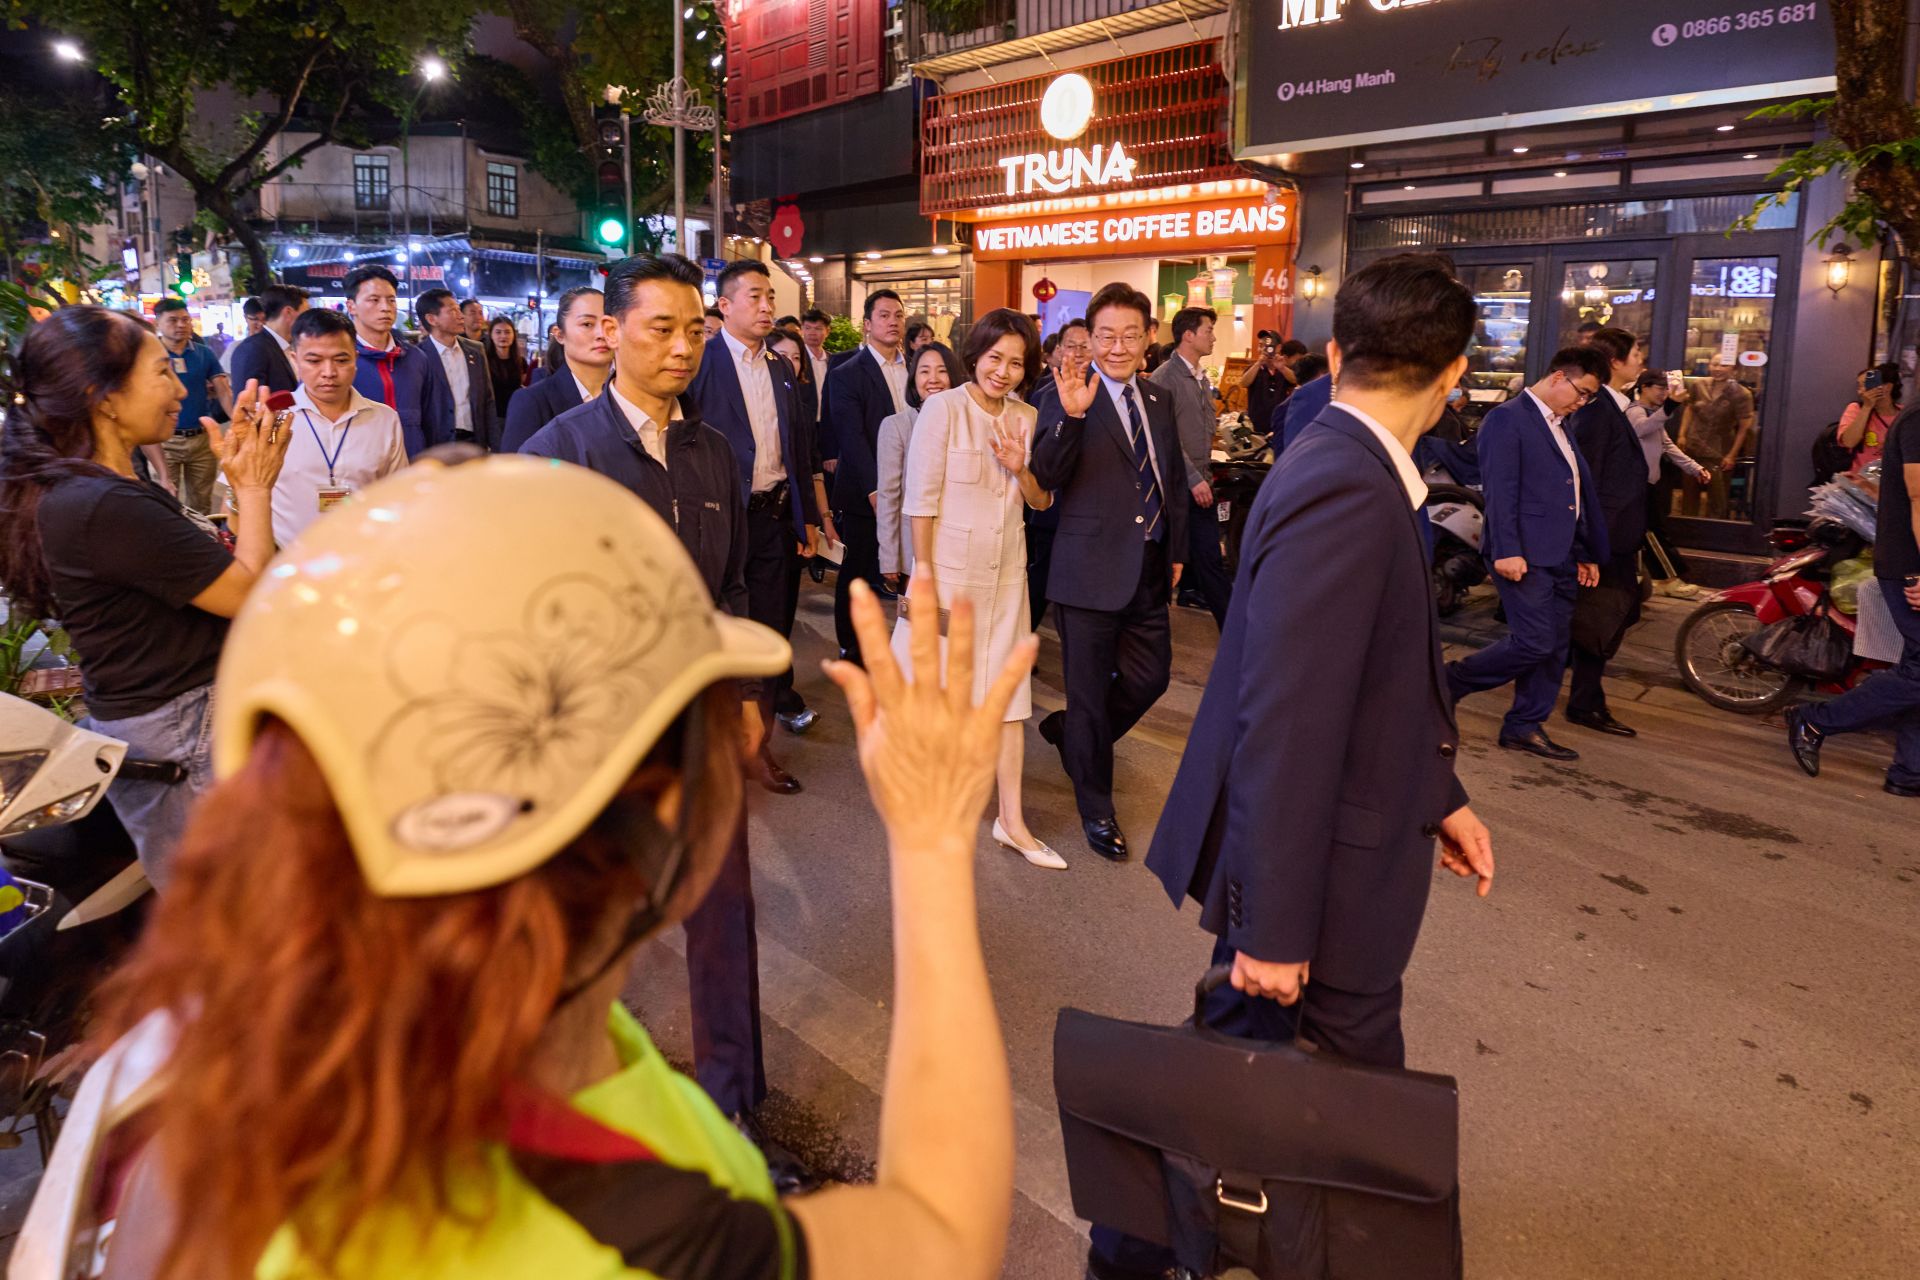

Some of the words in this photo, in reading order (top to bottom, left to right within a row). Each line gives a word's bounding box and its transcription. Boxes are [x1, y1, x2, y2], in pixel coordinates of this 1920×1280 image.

[1682, 17, 1731, 39] 0866
[1735, 9, 1774, 30] 365
[1778, 2, 1817, 24] 681
[1296, 82, 1315, 95] 44
[1316, 78, 1352, 95] Hang
[1355, 69, 1396, 88] Manh
[998, 141, 1138, 197] TRUNA
[976, 219, 1099, 251] VIETNAMESE
[1103, 212, 1191, 243] COFFEE
[1196, 204, 1287, 237] BEANS
[1261, 268, 1289, 290] 46
